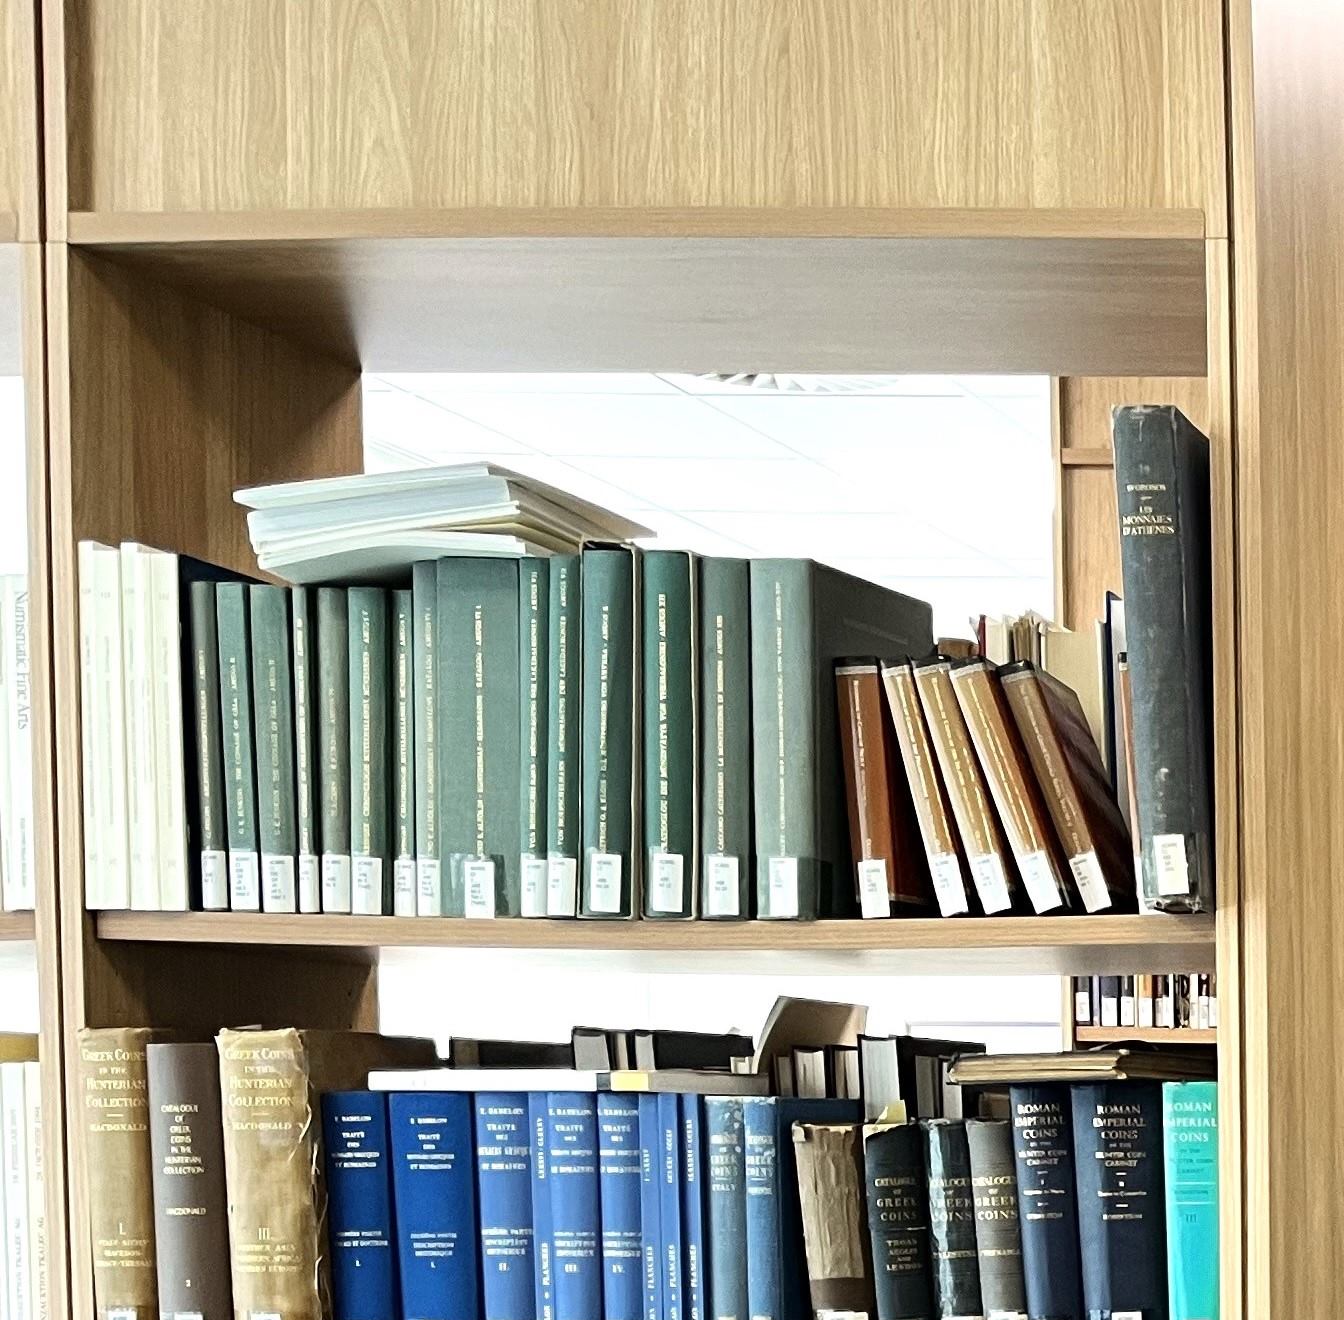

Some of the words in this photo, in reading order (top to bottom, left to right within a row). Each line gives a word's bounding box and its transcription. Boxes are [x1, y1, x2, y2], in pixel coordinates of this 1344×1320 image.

[1122, 515, 1173, 525] MONNAIES
[18, 703, 29, 730] Arts
[86, 1078, 146, 1090] HUNTERIAN
[229, 1077, 293, 1089] HUNTERIAN
[86, 1097, 148, 1108] COLLECTION
[229, 1096, 295, 1107] COLLECTION
[1165, 1102, 1212, 1112] ROMAN
[1017, 1104, 1060, 1115] ROMAN
[1097, 1104, 1141, 1115] ROMAN
[1014, 1117, 1066, 1128] IMPERIAL
[1093, 1117, 1147, 1128] IMPERIAL
[1164, 1117, 1217, 1128] IMPERIAL
[1023, 1129, 1058, 1139] COINS
[1101, 1130, 1138, 1140] COINS
[1171, 1132, 1209, 1143] COINS
